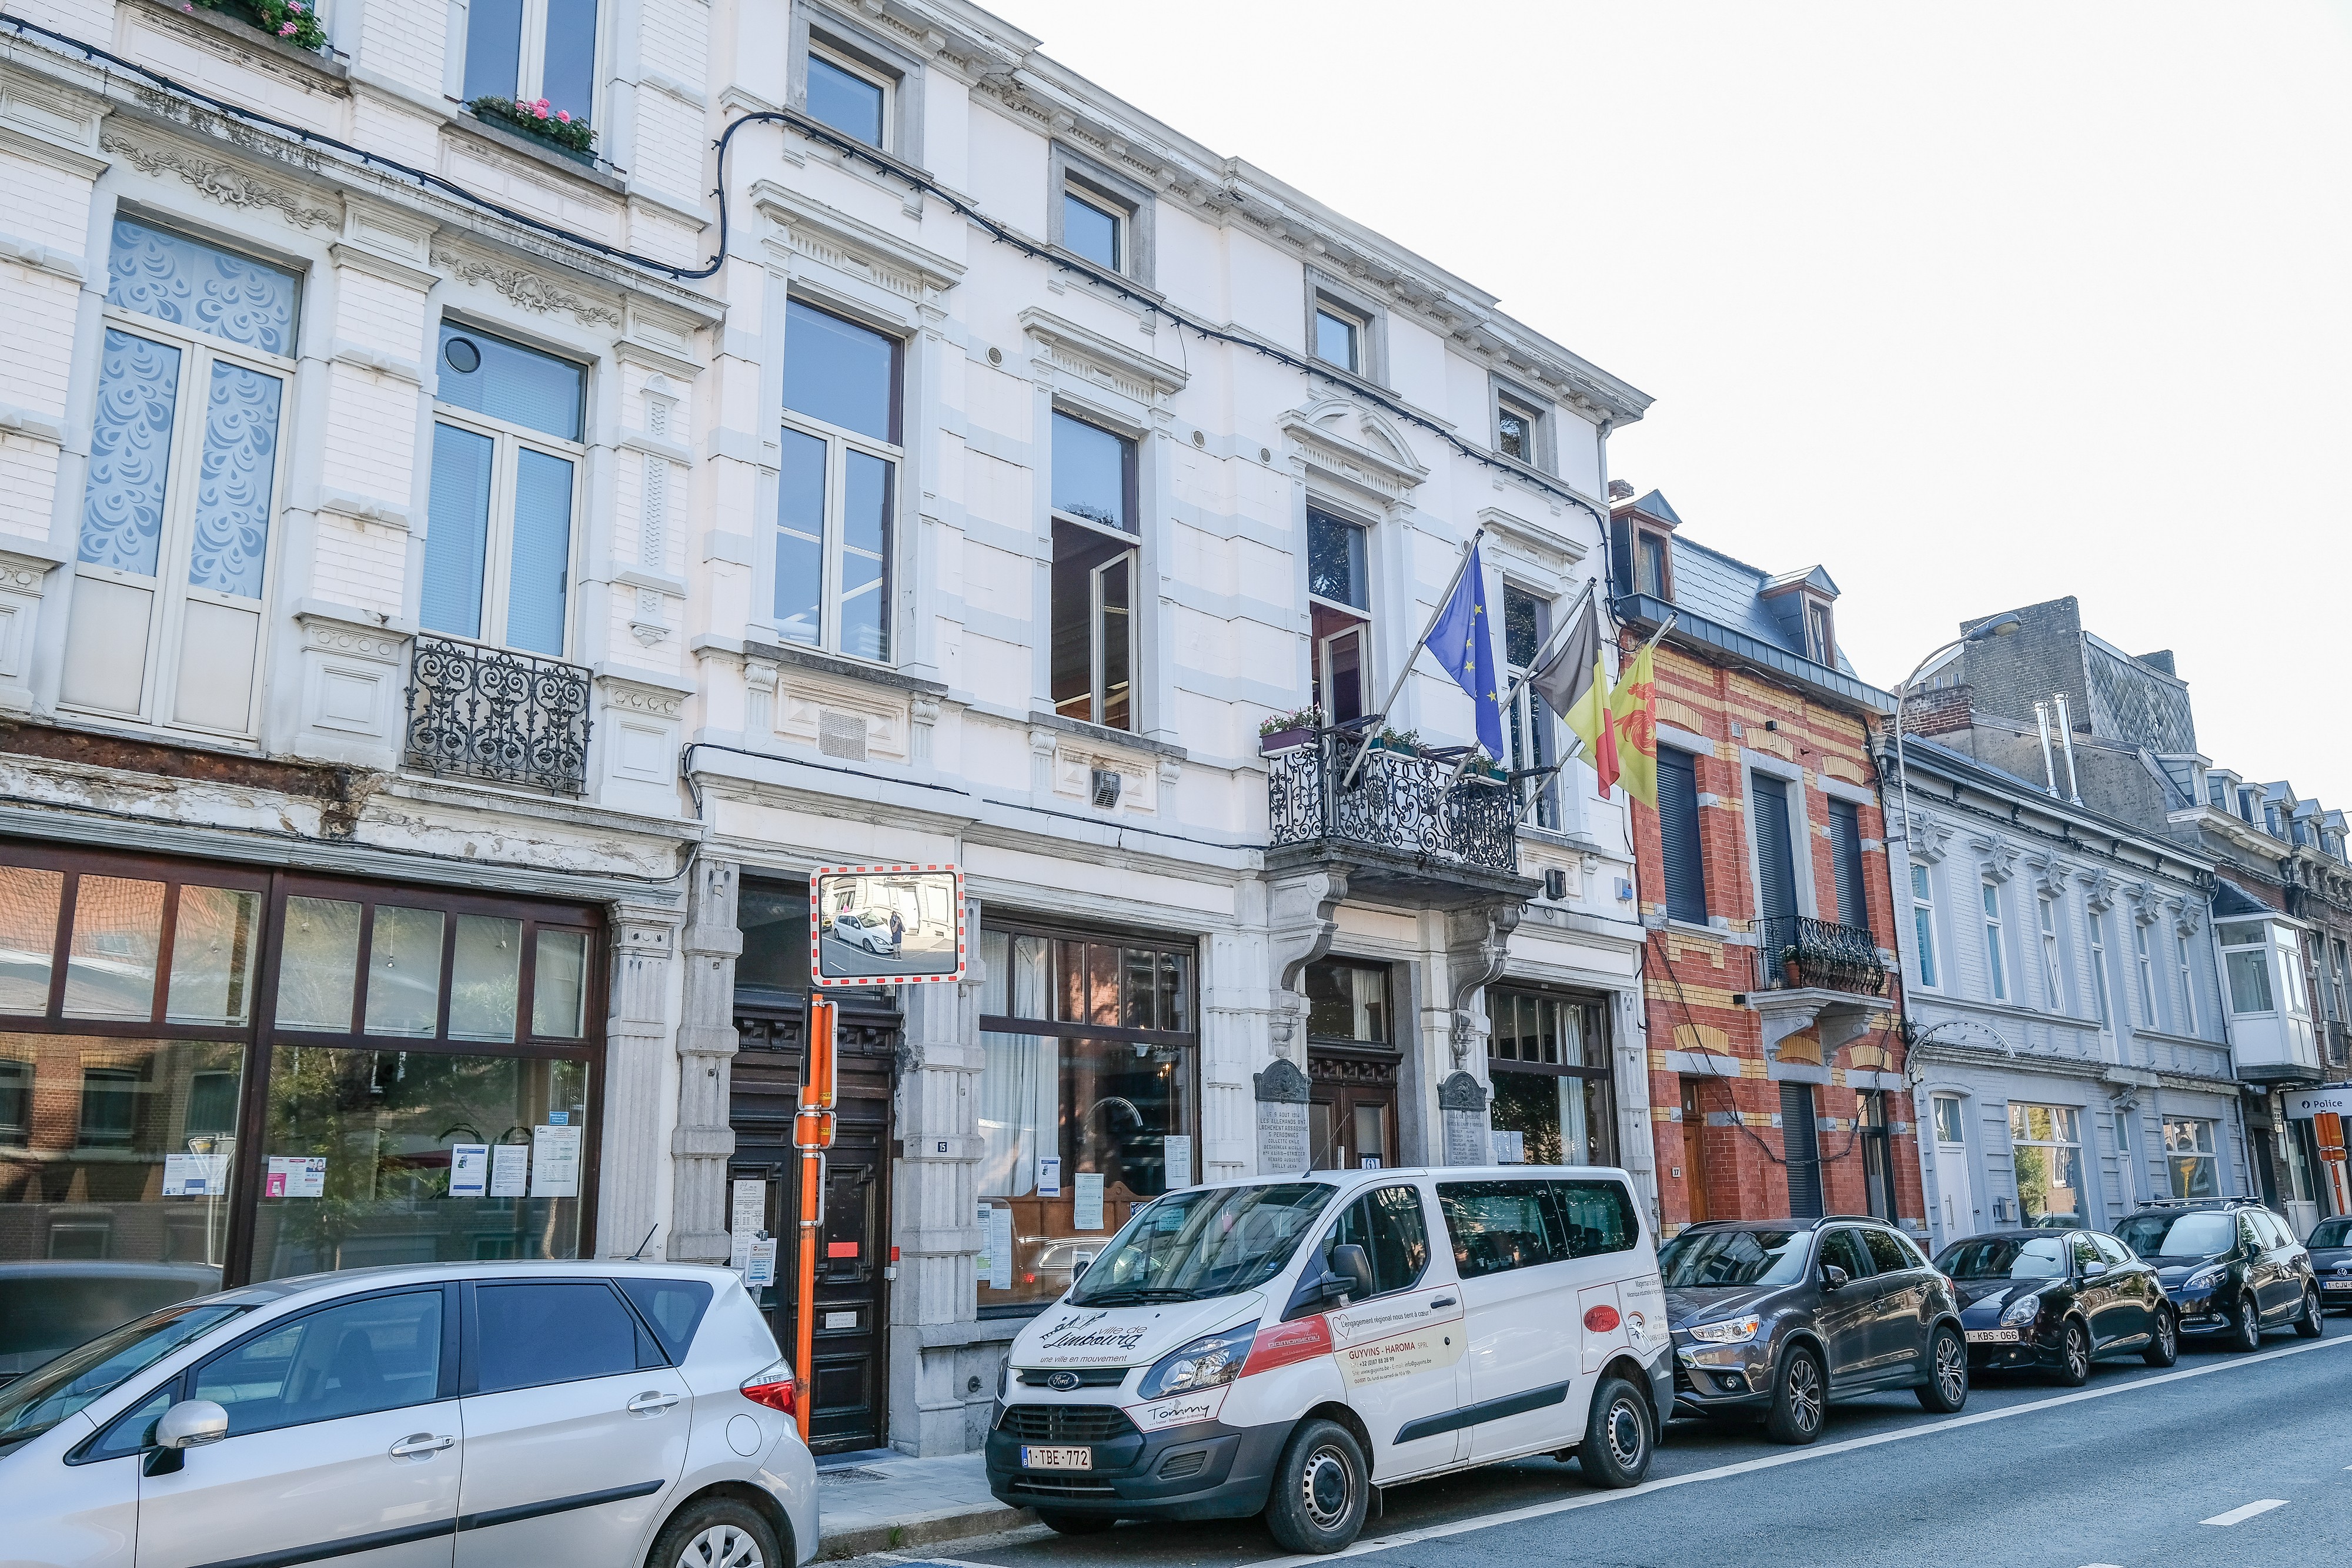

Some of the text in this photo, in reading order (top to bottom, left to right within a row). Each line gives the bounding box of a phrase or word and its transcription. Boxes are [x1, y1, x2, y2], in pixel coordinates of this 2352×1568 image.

[2314, 1099, 2343, 1108] Police
[940, 1143, 946, 1151] 15
[1341, 1317, 1374, 1328] L'engagement
[1374, 1314, 1392, 1324] régional
[1098, 1325, 1148, 1335] ville de
[1043, 1332, 1142, 1350] Limbourg
[1268, 1335, 1320, 1348] DAMOISEAU
[1349, 1347, 1380, 1359] GUYVINS
[1385, 1342, 1416, 1354] HAROMA
[1361, 1365, 1389, 1375] www.guyvins.be
[1404, 1358, 1432, 1368] info@guyvins.be
[1053, 1375, 1070, 1385] Ford
[1147, 1405, 1210, 1420] Tommy
